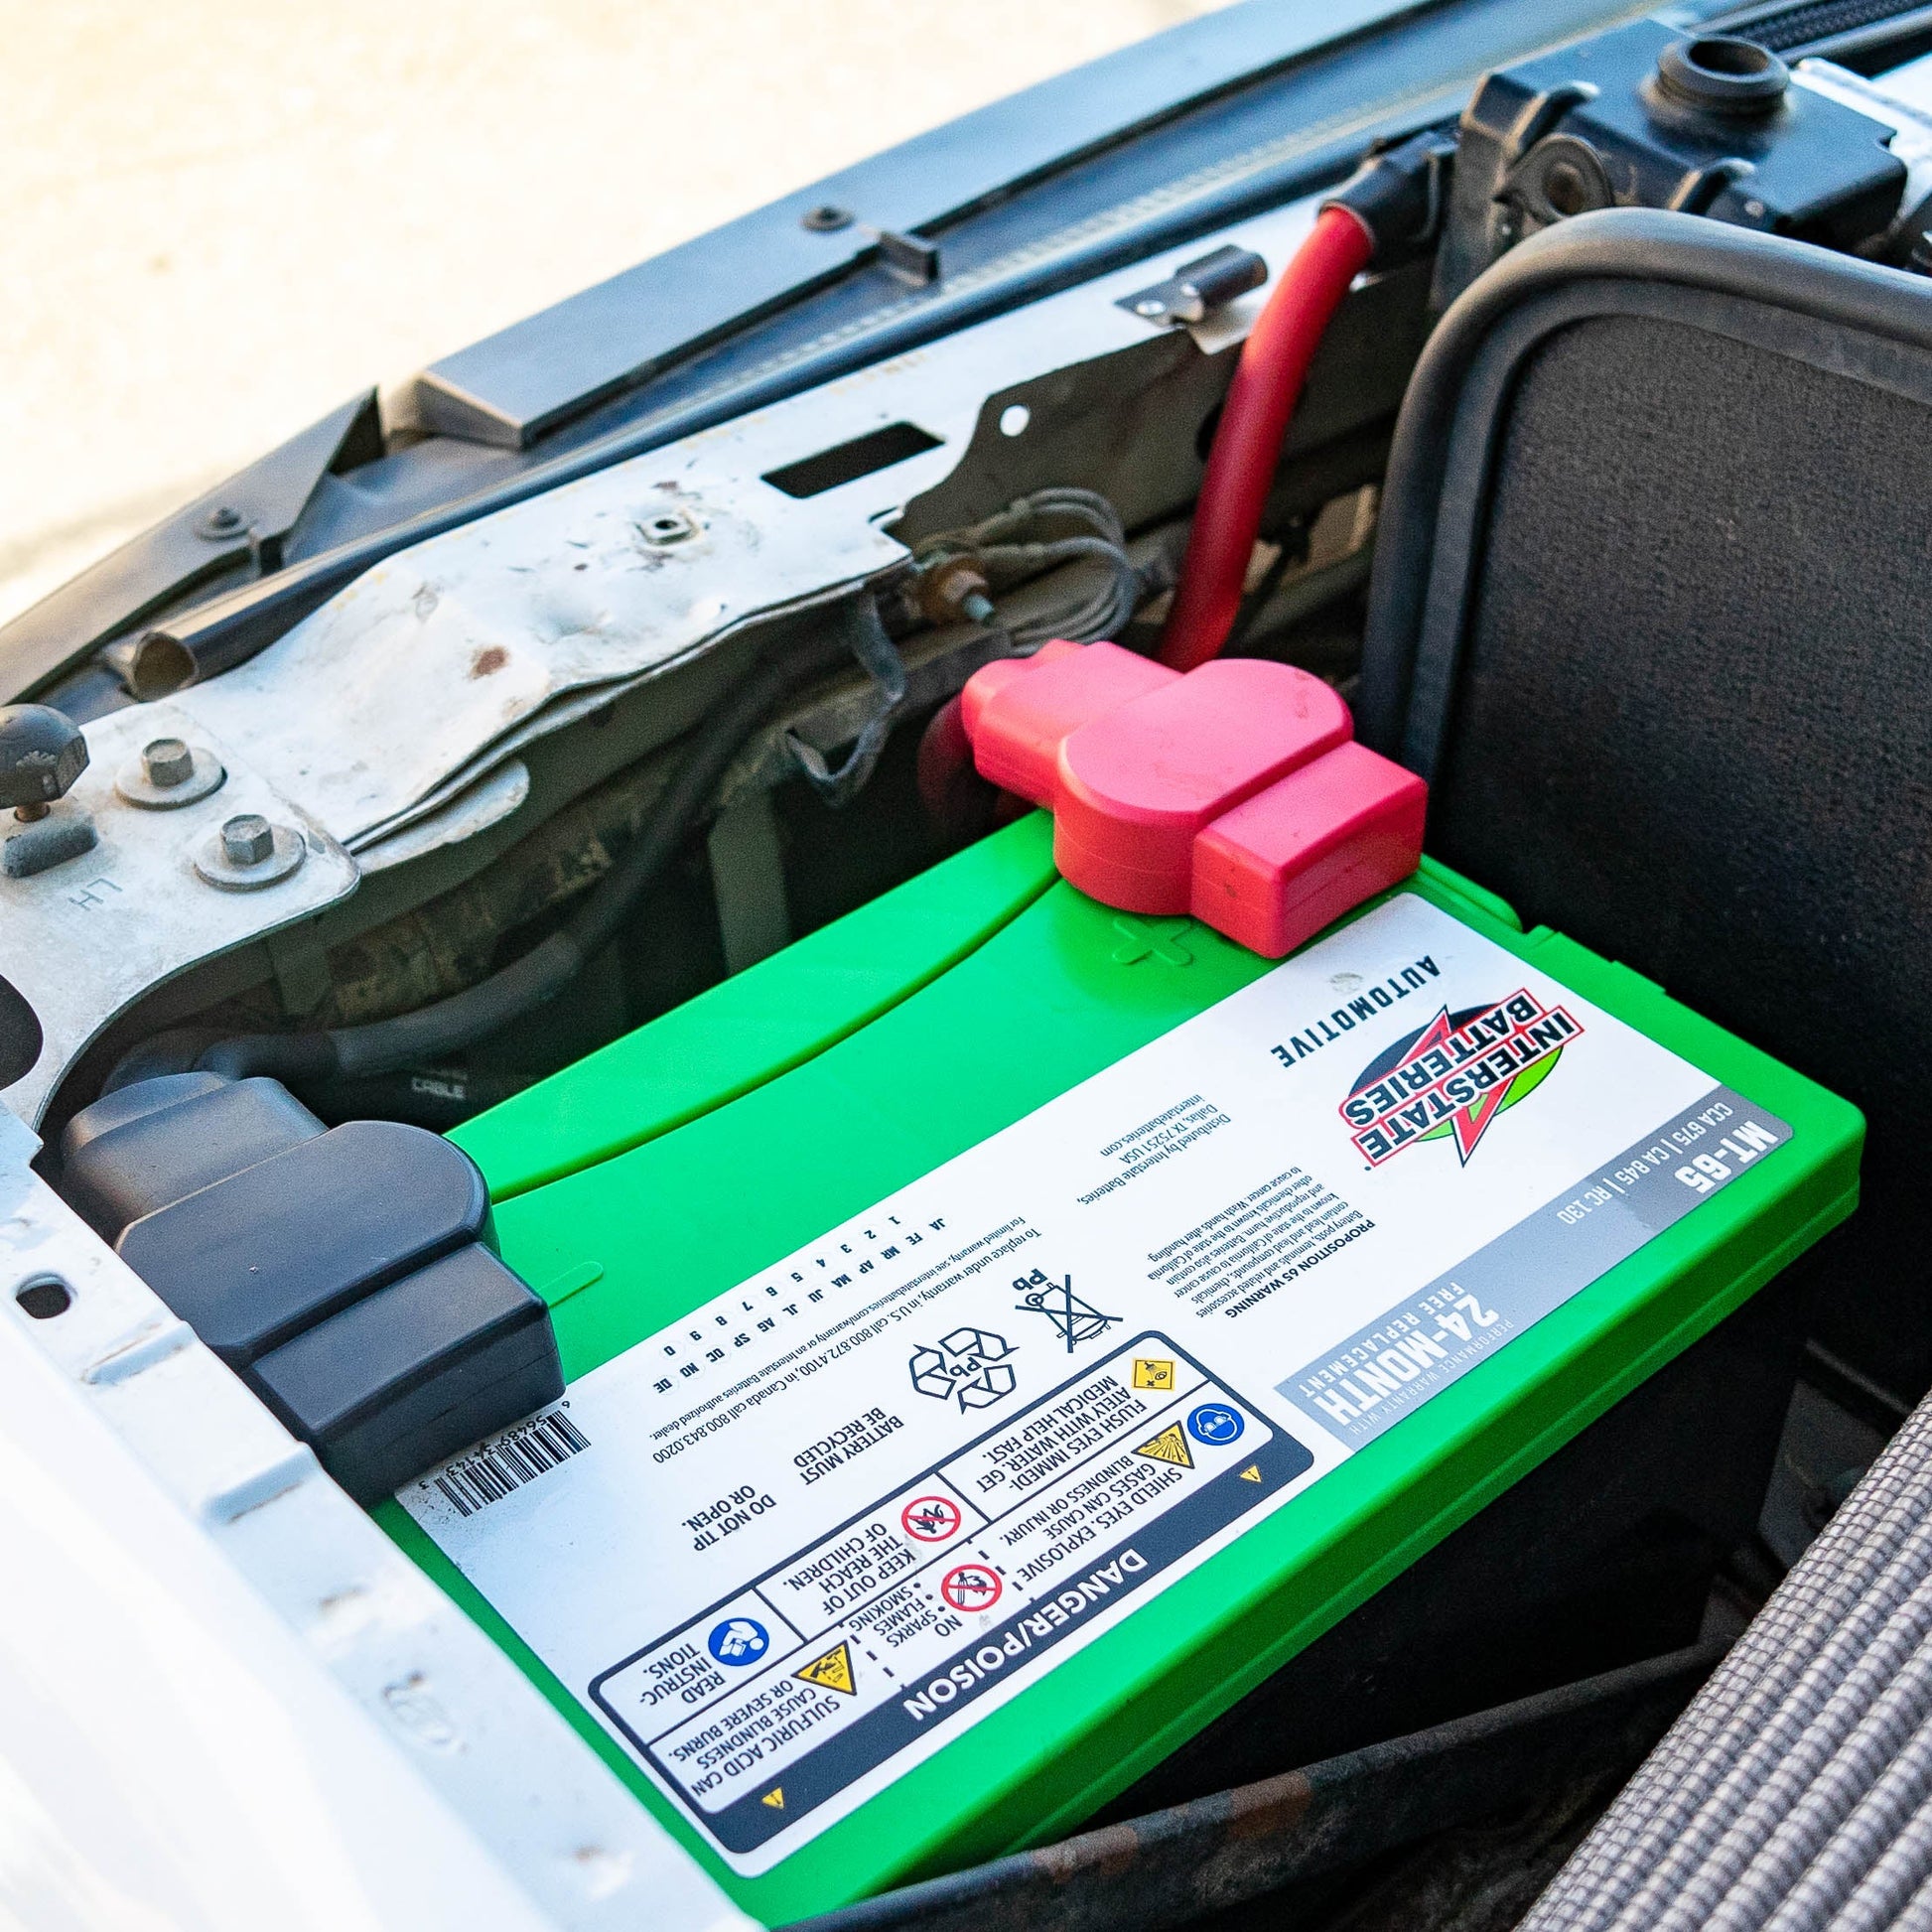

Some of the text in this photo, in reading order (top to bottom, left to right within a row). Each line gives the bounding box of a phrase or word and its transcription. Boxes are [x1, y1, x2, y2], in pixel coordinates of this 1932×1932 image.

[1270, 955, 1441, 1068] AUTOMOTIVE
[1338, 995, 1546, 1130] BATTERIES
[1352, 1012, 1583, 1160] INTERSTATE
[1076, 1113, 1232, 1205] Distributed by Interstate Batteries,
[1100, 1094, 1205, 1157] interstatebatteries.com
[1118, 1104, 1218, 1165] Dallas, TX 75251 USA
[1556, 1102, 1733, 1225] CCA 675 CA 845 RC 130
[1674, 1120, 1779, 1194] MT-65
[1166, 1183, 1325, 1286] and reproductive harm. Batteries also contain
[1190, 1201, 1349, 1305] contain lead and lead compounds, chemicals
[1195, 1209, 1364, 1318] Battery posts, terminals and related accessories
[1224, 1219, 1376, 1318] PROPOSITION 65 WARNING
[652, 1218, 946, 1394] JA FE MR AP MA JU JL AG SP OC NO DE
[663, 1215, 900, 1356] 1 2 3 4 5 6 7 8 9 0
[1012, 1268, 1048, 1292] Pb
[649, 1216, 1027, 1441] For limited warranty, see interstatebatteries.com/warranty or an Interstate Batteries authorized dealer.
[652, 1228, 1042, 1463] To replace under warranty, in U.S. call 800.872.4100, in Canada call 800.843.0200
[949, 1356, 983, 1377] Pb
[1298, 1282, 1465, 1398] FREE REPLACEMENT
[1312, 1294, 1500, 1427] 24-MONTH
[559, 1399, 573, 1410] 6
[1348, 1318, 1515, 1437] PERFORMANCE WARRANTY WITH
[494, 1414, 549, 1449] 56489
[793, 1407, 887, 1468] BE RECYCLED
[799, 1415, 904, 1485] BATTERY MUST
[976, 1386, 1132, 1493] ATELY WITH WATER. GET
[982, 1375, 1119, 1464] MEDICAL HELP FAST.
[1009, 1399, 1148, 1491] FLUSH EYES IMMEDI-
[416, 1479, 431, 1491] 3
[681, 1485, 756, 1532] OR OPEN.
[693, 1493, 777, 1552] DO NOT TIP
[999, 1454, 1135, 1547] BLINDNESS OR INJURY.
[1016, 1467, 1182, 1582] SHIELD EYES. EXPLOSIVE
[1042, 1463, 1157, 1540] GASES CAN CAUSE
[782, 1523, 888, 1591] OF CHILDREN.
[818, 1535, 903, 1593] THE REACH
[822, 1548, 916, 1616] KEEP OUT OF
[848, 1586, 913, 1632] SMOKING
[873, 1597, 926, 1636] FLAMES
[886, 1609, 938, 1648] SPARKS
[902, 1548, 1149, 1721] DANGER/POISON
[934, 1614, 963, 1637] NO
[639, 1656, 713, 1706] INSTRUC-
[642, 1643, 701, 1680] TIONS.
[680, 1671, 727, 1704] READ
[668, 1680, 794, 1762] OR SEVERE BURNS.
[691, 1695, 841, 1797] SULFURIC ACID CAN
[696, 1688, 817, 1770] CAUSE BLINDNESS
